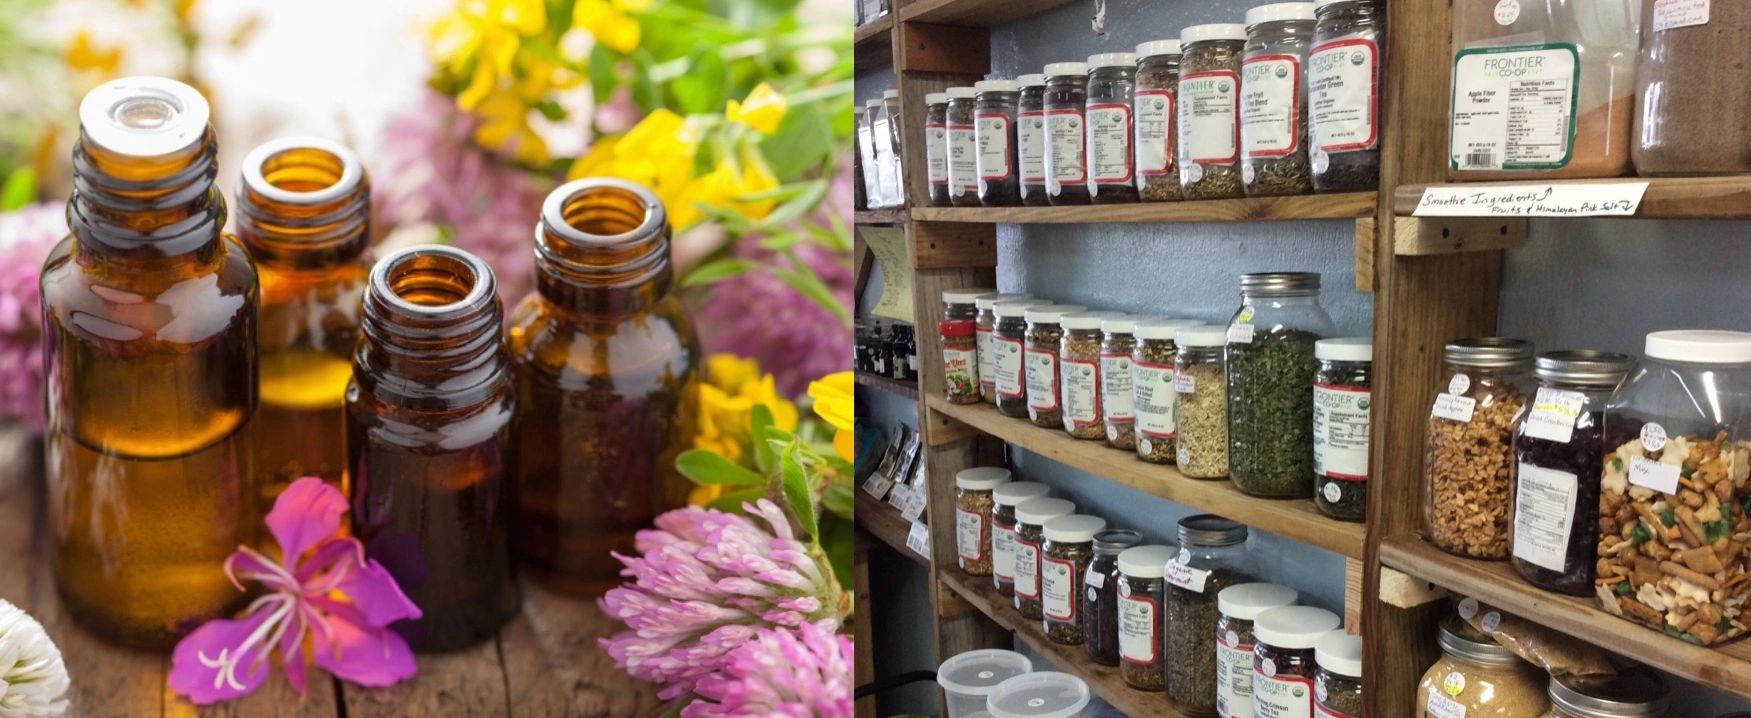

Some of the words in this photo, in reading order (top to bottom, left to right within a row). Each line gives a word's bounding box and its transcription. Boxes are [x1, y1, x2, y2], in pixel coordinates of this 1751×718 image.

[1484, 56, 1544, 70] FRONTIER
[1499, 69, 1527, 77] CO-OP
[1491, 206, 1521, 214] Fruits
[1580, 202, 1597, 212] Pink
